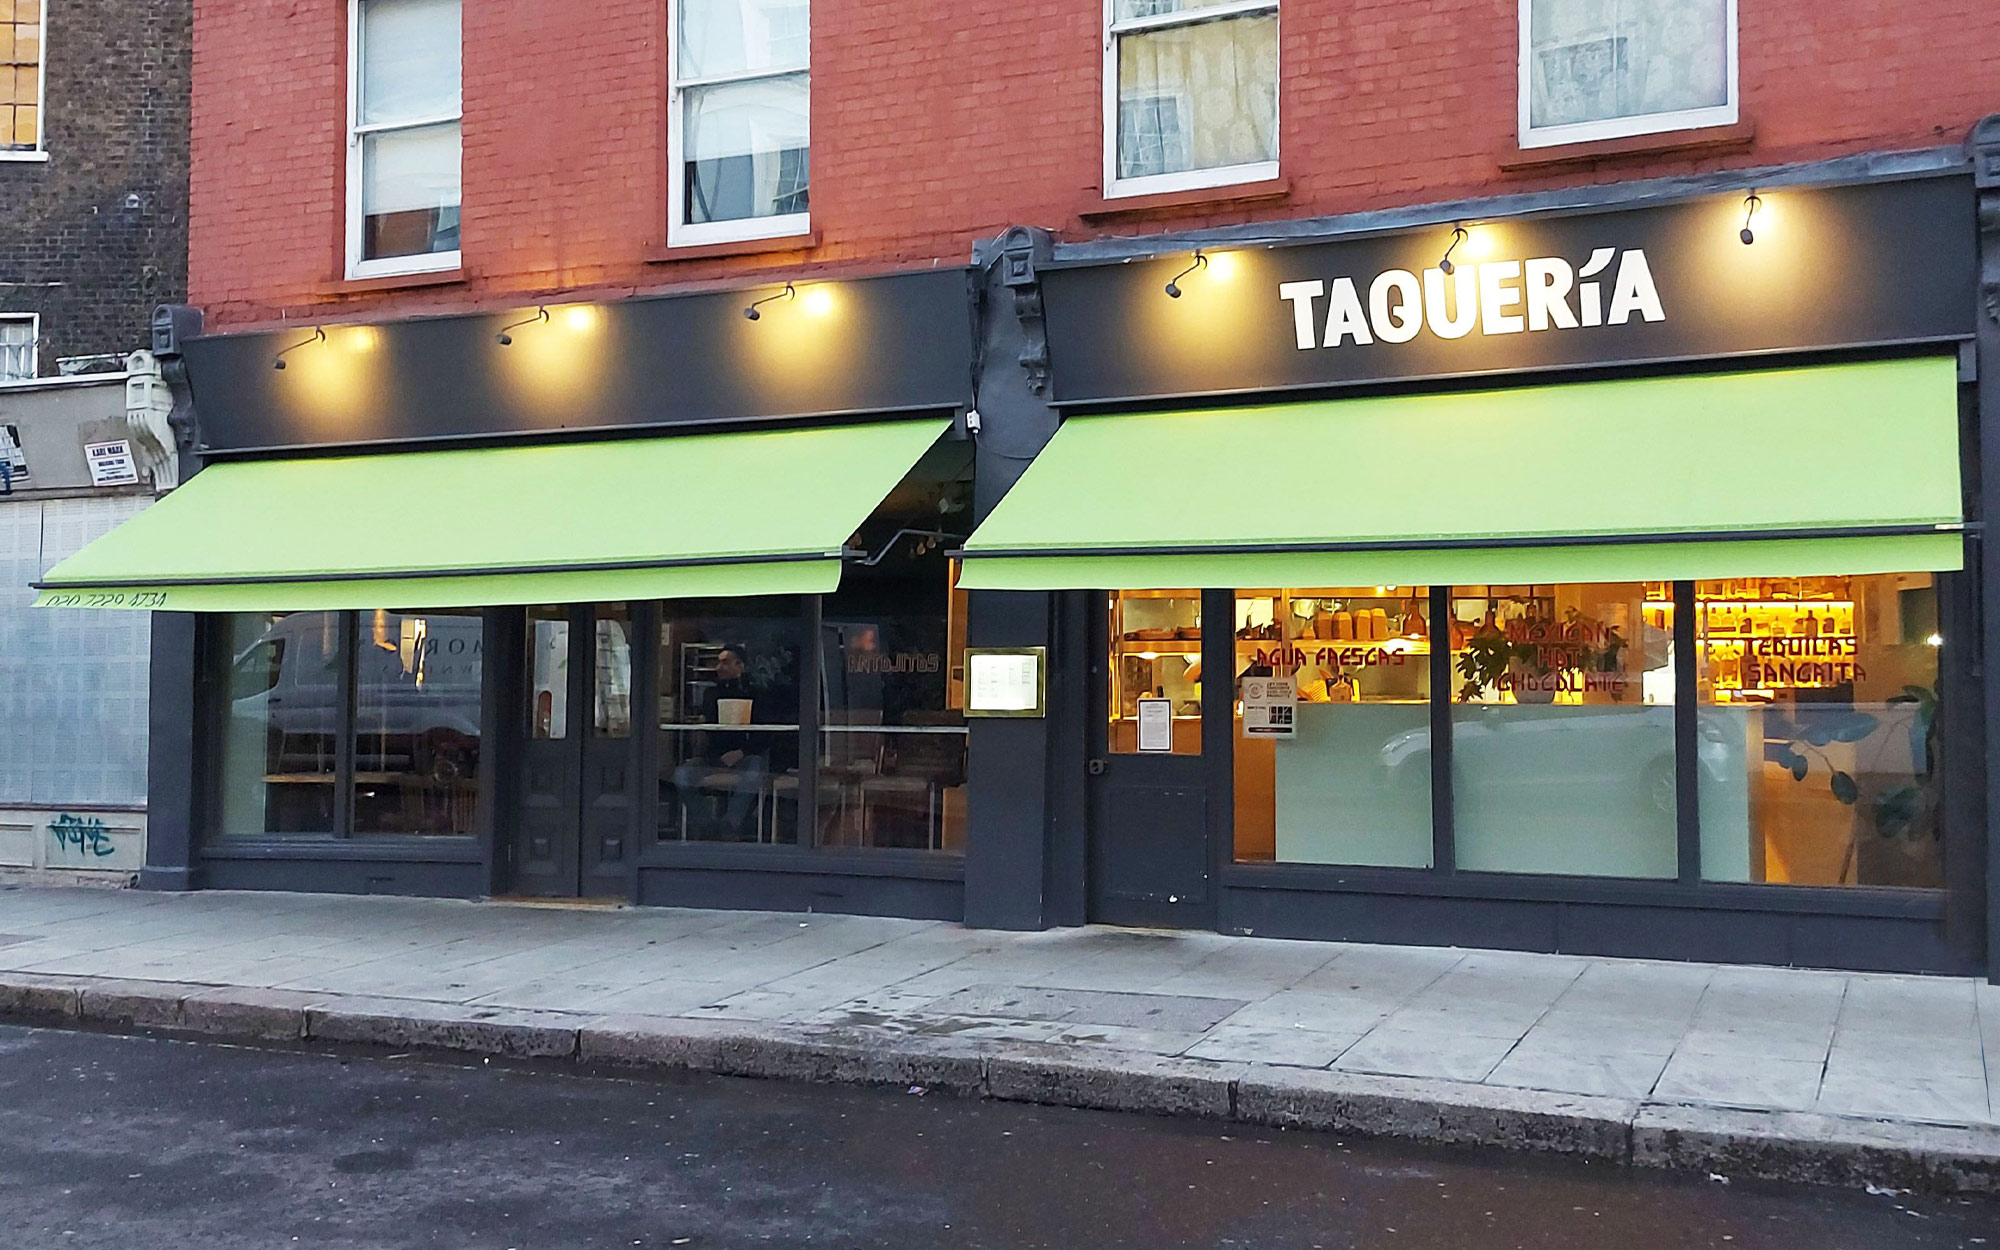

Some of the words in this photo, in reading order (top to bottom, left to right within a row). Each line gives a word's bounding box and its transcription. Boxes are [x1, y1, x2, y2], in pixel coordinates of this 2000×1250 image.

[1508, 622, 1611, 644] MEXICAN
[1315, 647, 1405, 666] FRESCAS
[1537, 645, 1580, 668] HOT
[1743, 635, 1858, 657] TEQUILAS
[1497, 671, 1627, 692] CHOCOLATE
[1748, 661, 1866, 684] SANGRITA
